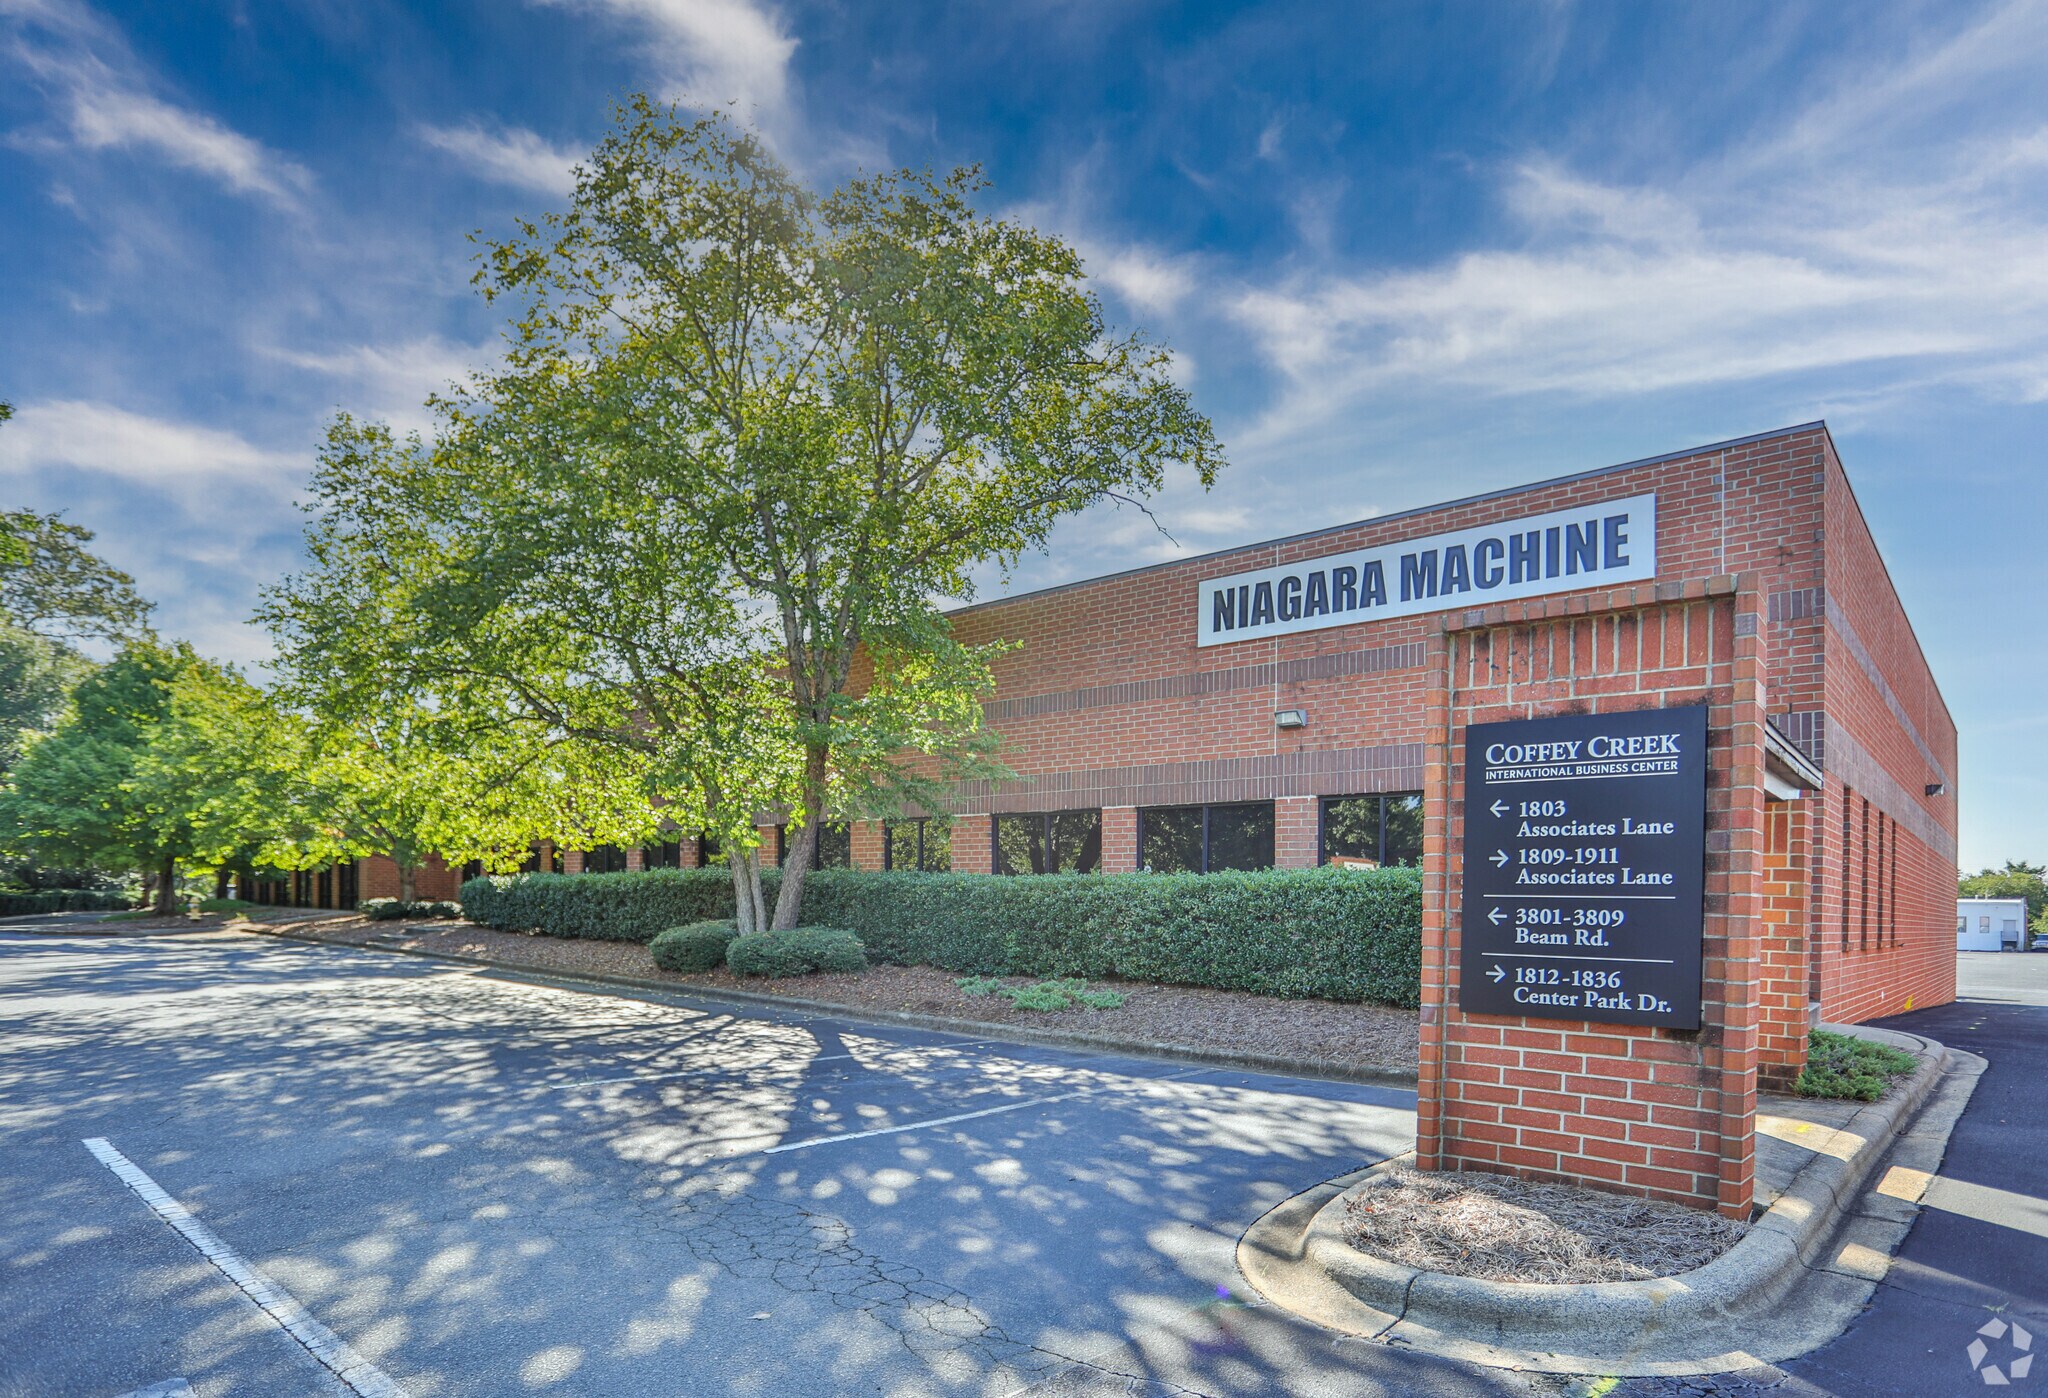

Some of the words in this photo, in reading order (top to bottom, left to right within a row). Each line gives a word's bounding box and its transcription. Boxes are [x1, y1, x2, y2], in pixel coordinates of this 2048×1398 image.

[1212, 559, 1388, 633] NIAGARA
[1400, 513, 1630, 603] MACHINE
[1485, 740, 1583, 765] COFFEY
[1587, 733, 1681, 759] CREEK
[1485, 766, 1573, 780] INTERNATIONAL
[1576, 763, 1629, 775] BUSINESS
[1631, 760, 1678, 773] CENTER
[1519, 800, 1566, 817] 1803
[1516, 820, 1616, 838] Associates
[1621, 818, 1674, 835] Lane
[1518, 847, 1619, 865] 1809-1911
[1515, 868, 1615, 885] Associates
[1621, 867, 1673, 885] Lane
[1515, 908, 1624, 927] 3801-3809
[1514, 927, 1568, 946] Beam
[1574, 928, 1610, 947] Rd.
[1514, 967, 1621, 989] 1812-1836
[1513, 986, 1579, 1007] Center
[1583, 990, 1632, 1011] Park
[1637, 993, 1673, 1013] Dr.
